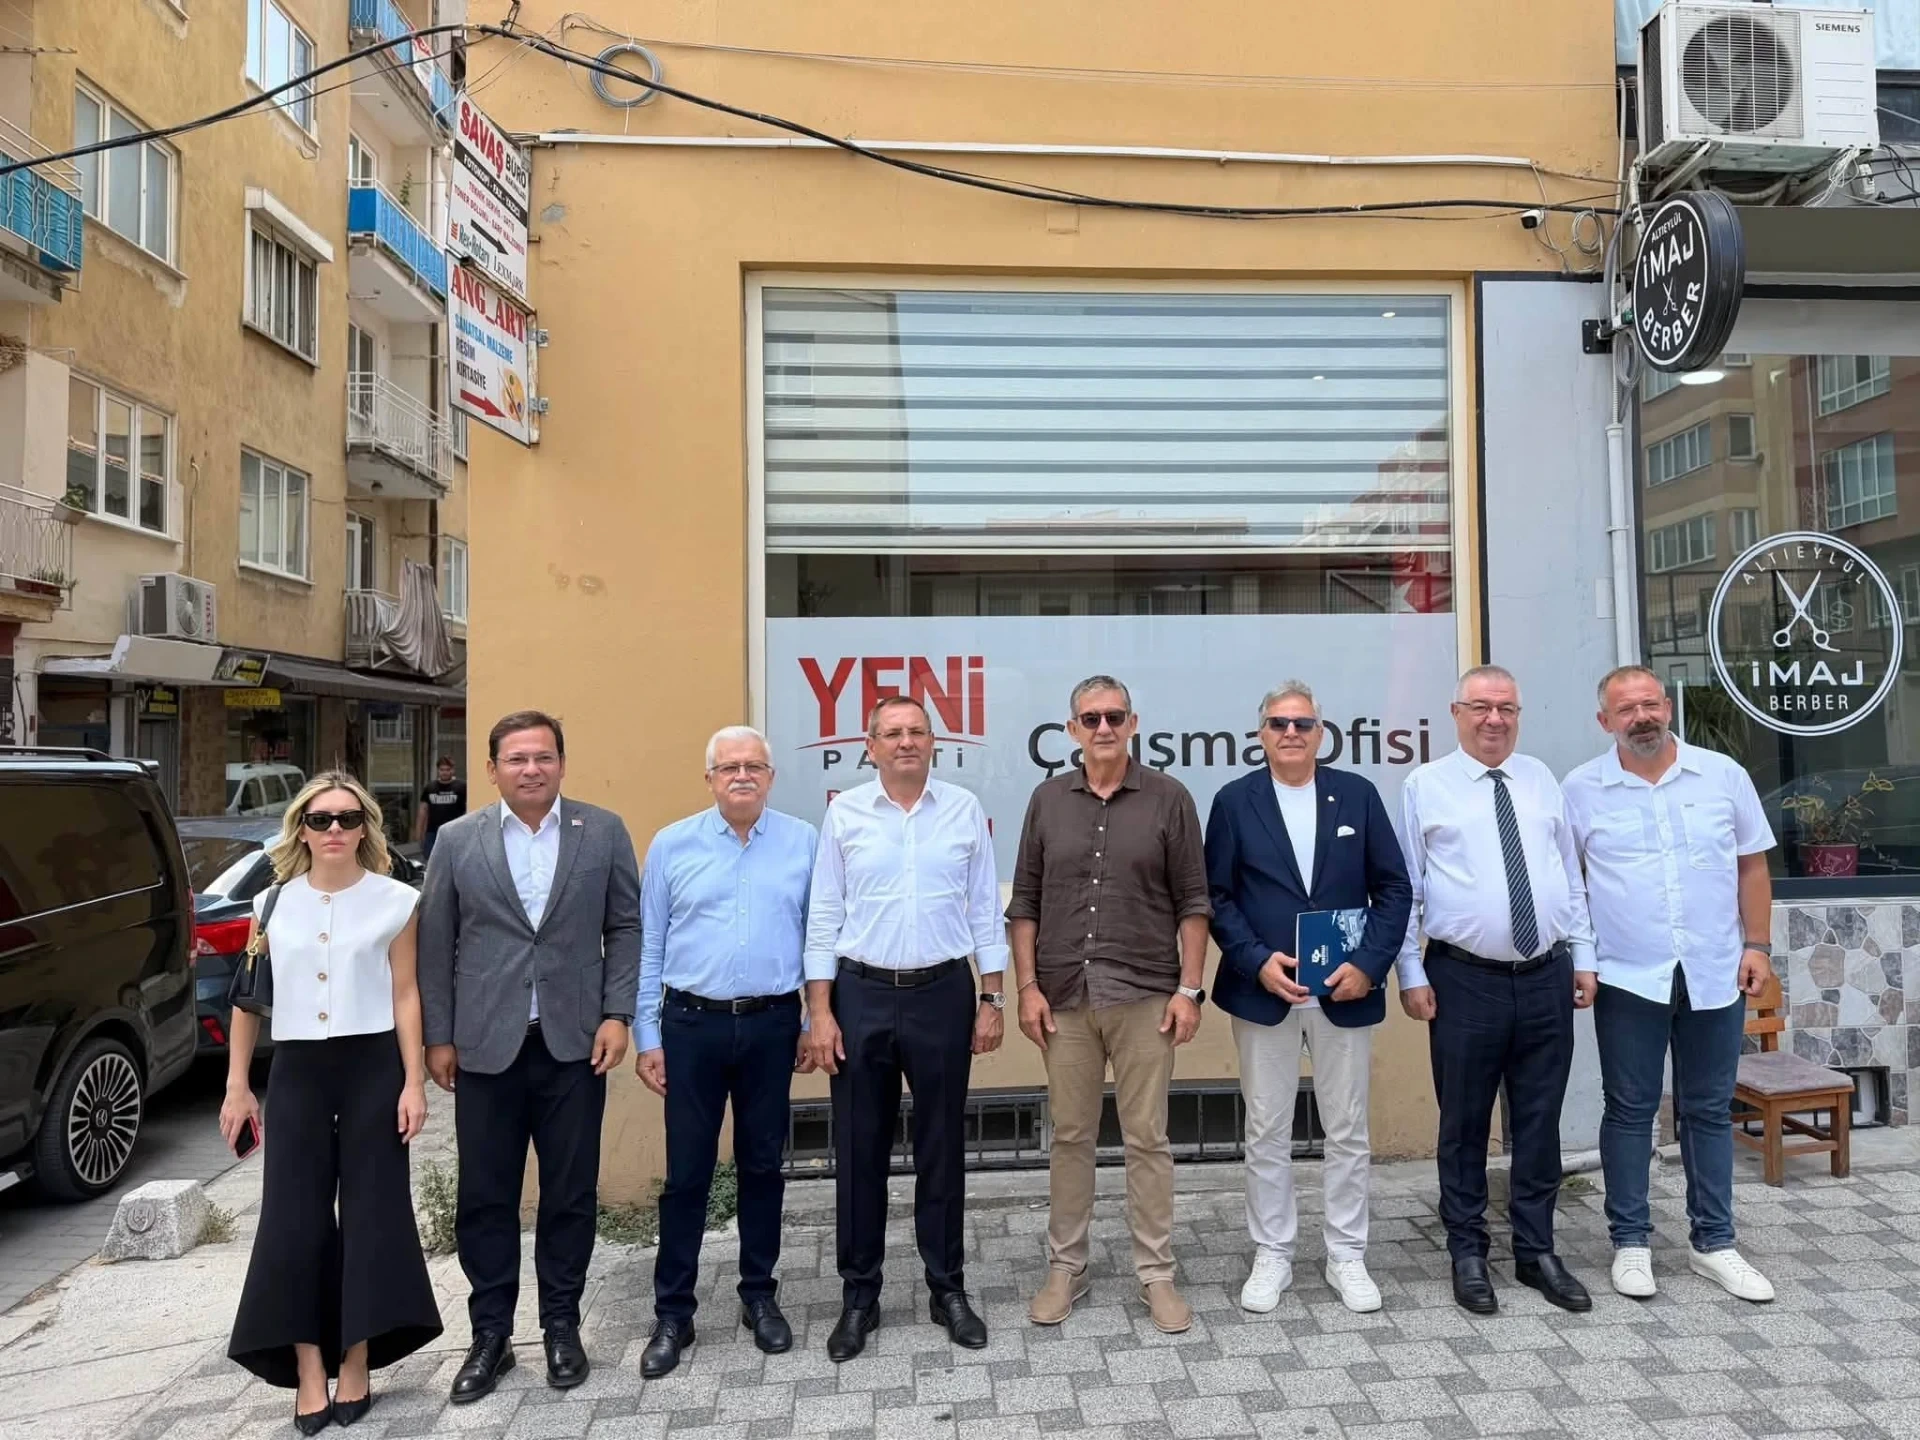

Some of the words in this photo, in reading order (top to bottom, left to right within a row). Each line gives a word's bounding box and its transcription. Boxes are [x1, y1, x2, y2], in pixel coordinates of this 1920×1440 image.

[1815, 22, 1861, 34] SIEMENS
[460, 101, 504, 179] SAVAŞ
[505, 151, 527, 189] BÜRO
[1641, 281, 1701, 351] BERBER
[456, 359, 487, 391] KIRTASİYE
[1742, 545, 1866, 585] ALTIEYLÜL
[1770, 695, 1849, 711] BERBER
